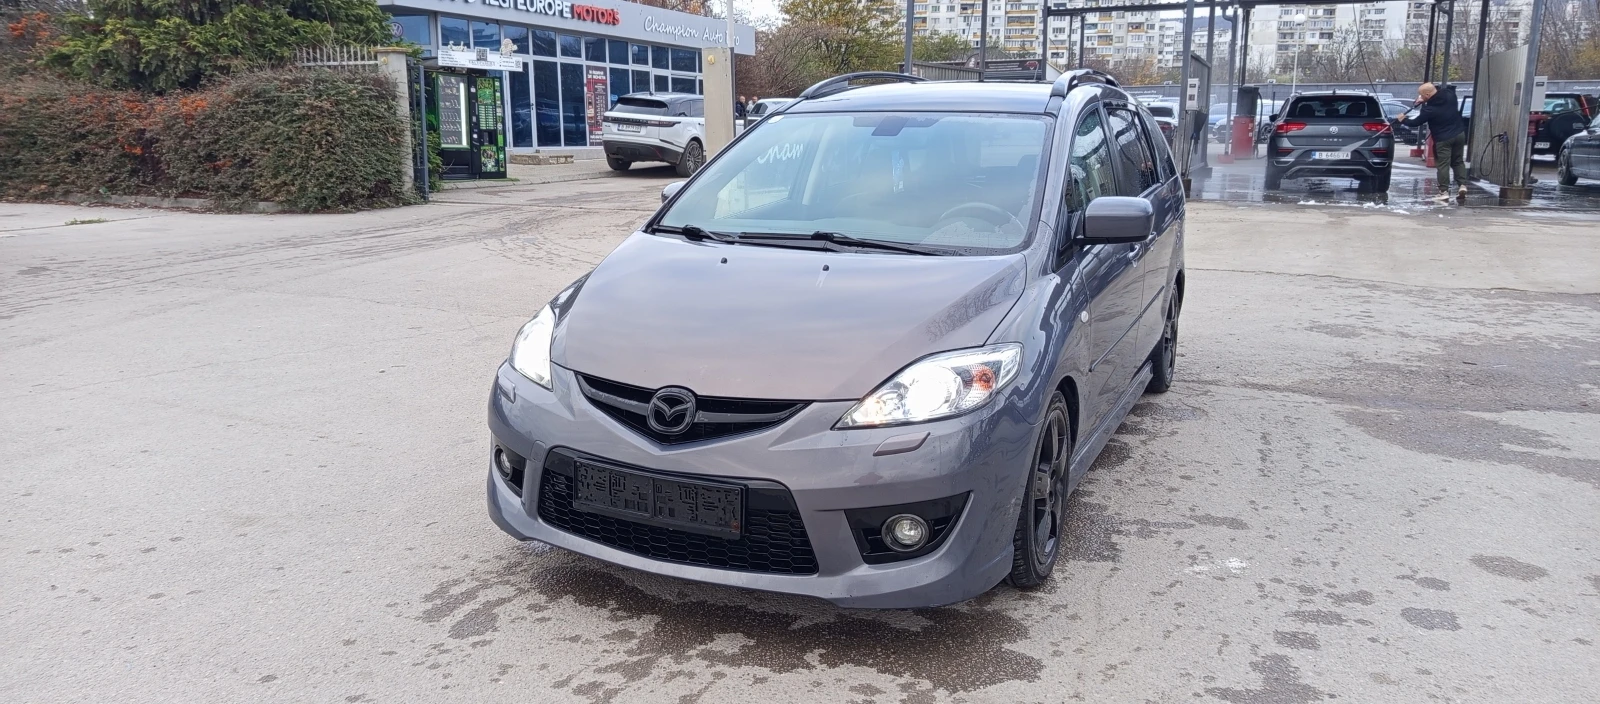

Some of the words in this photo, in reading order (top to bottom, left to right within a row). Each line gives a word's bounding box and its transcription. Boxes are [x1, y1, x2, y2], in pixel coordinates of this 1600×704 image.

[518, 0, 572, 18] EUROPE
[573, 4, 620, 25] MOTORS
[644, 16, 699, 40] Champion
[702, 26, 723, 44] Auto
